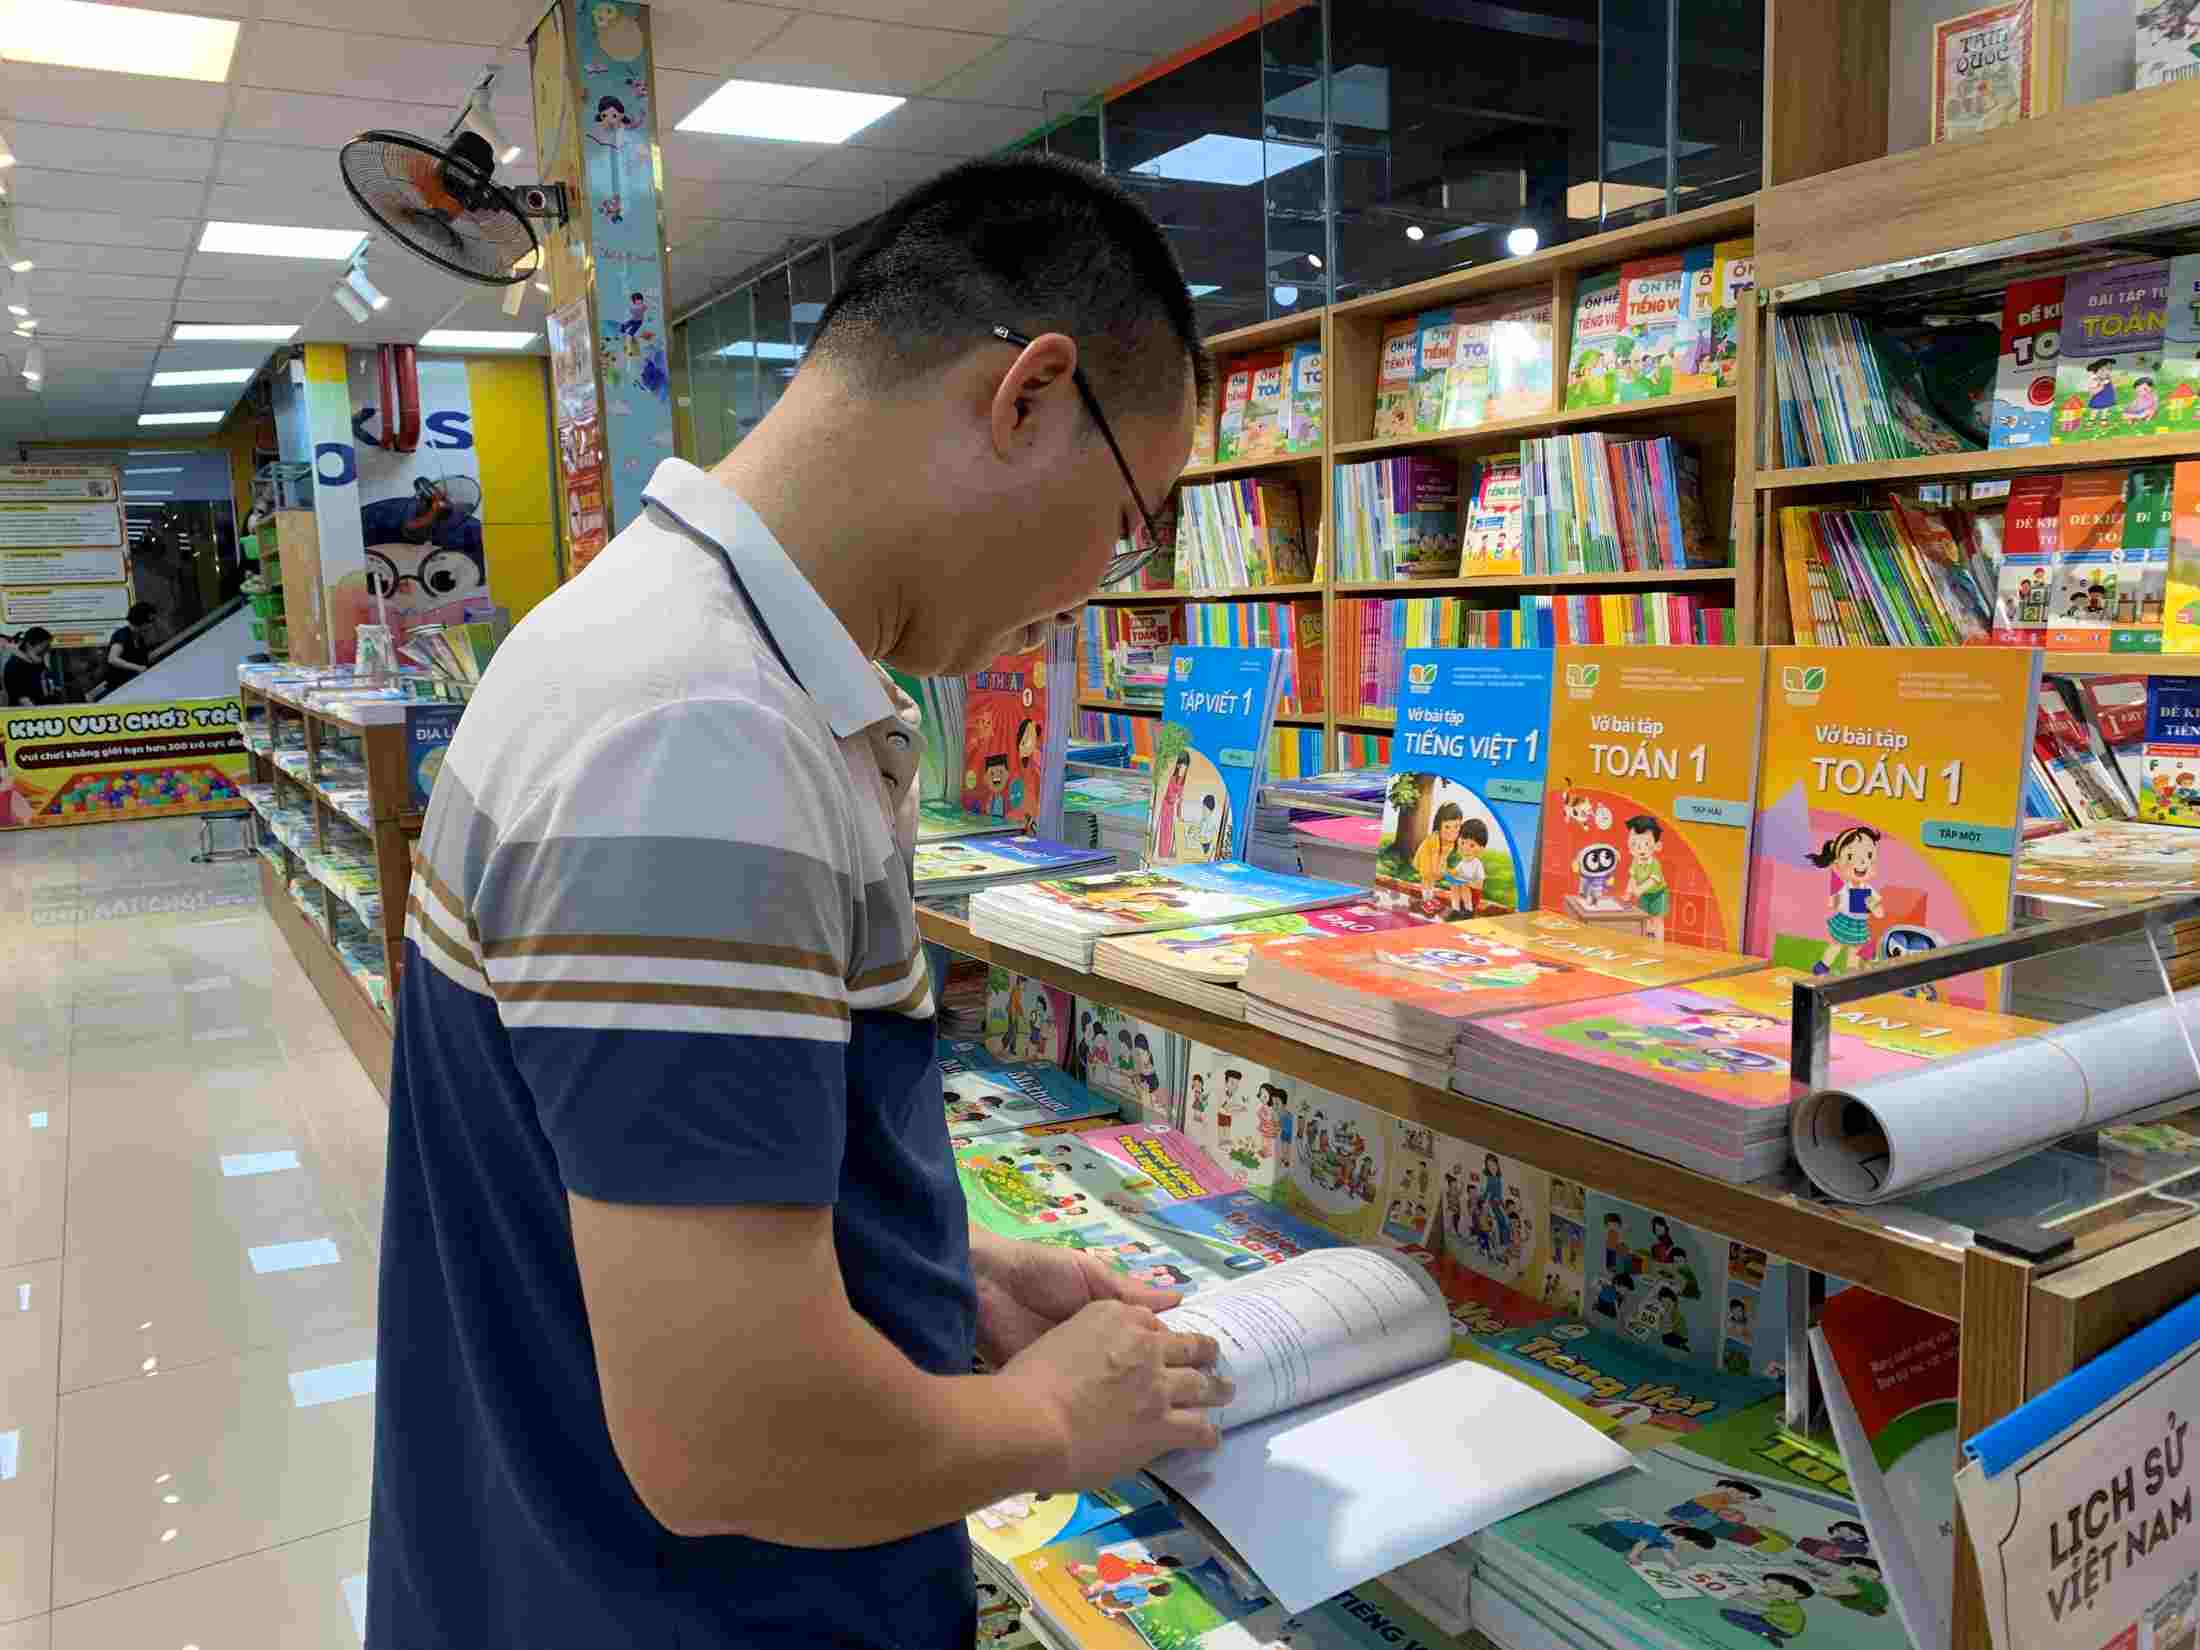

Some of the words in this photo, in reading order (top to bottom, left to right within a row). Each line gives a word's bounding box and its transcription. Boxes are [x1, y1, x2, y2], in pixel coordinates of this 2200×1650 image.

[1242, 688, 1253, 717] 1
[1407, 705, 1424, 723] Vở
[1424, 706, 1444, 723] bài
[1445, 709, 1465, 728] tập
[9, 717, 65, 740] KHU
[68, 714, 122, 735] VUI
[124, 707, 189, 732] CHƠI
[1590, 713, 1610, 733] Vở
[1612, 716, 1635, 735] bài
[1637, 717, 1665, 739] tập
[1815, 723, 1841, 744] Vở
[1843, 725, 1873, 746] bài
[1875, 727, 1909, 753] tập
[19, 753, 38, 763] Vui
[1404, 725, 1465, 759] TIẾNG
[1471, 732, 1518, 769] VIỆT
[1525, 729, 1539, 763] 1
[1589, 734, 1680, 781] TOÁN
[1689, 743, 1707, 784] 1
[1810, 753, 1929, 802] TOÁN
[1941, 758, 1963, 805] 1
[2049, 1464, 2136, 1572] LỊCH
[2144, 1409, 2189, 1497] SỬ
[2047, 1540, 2119, 1624] VIỆT
[2126, 1484, 2194, 1569] NAM
